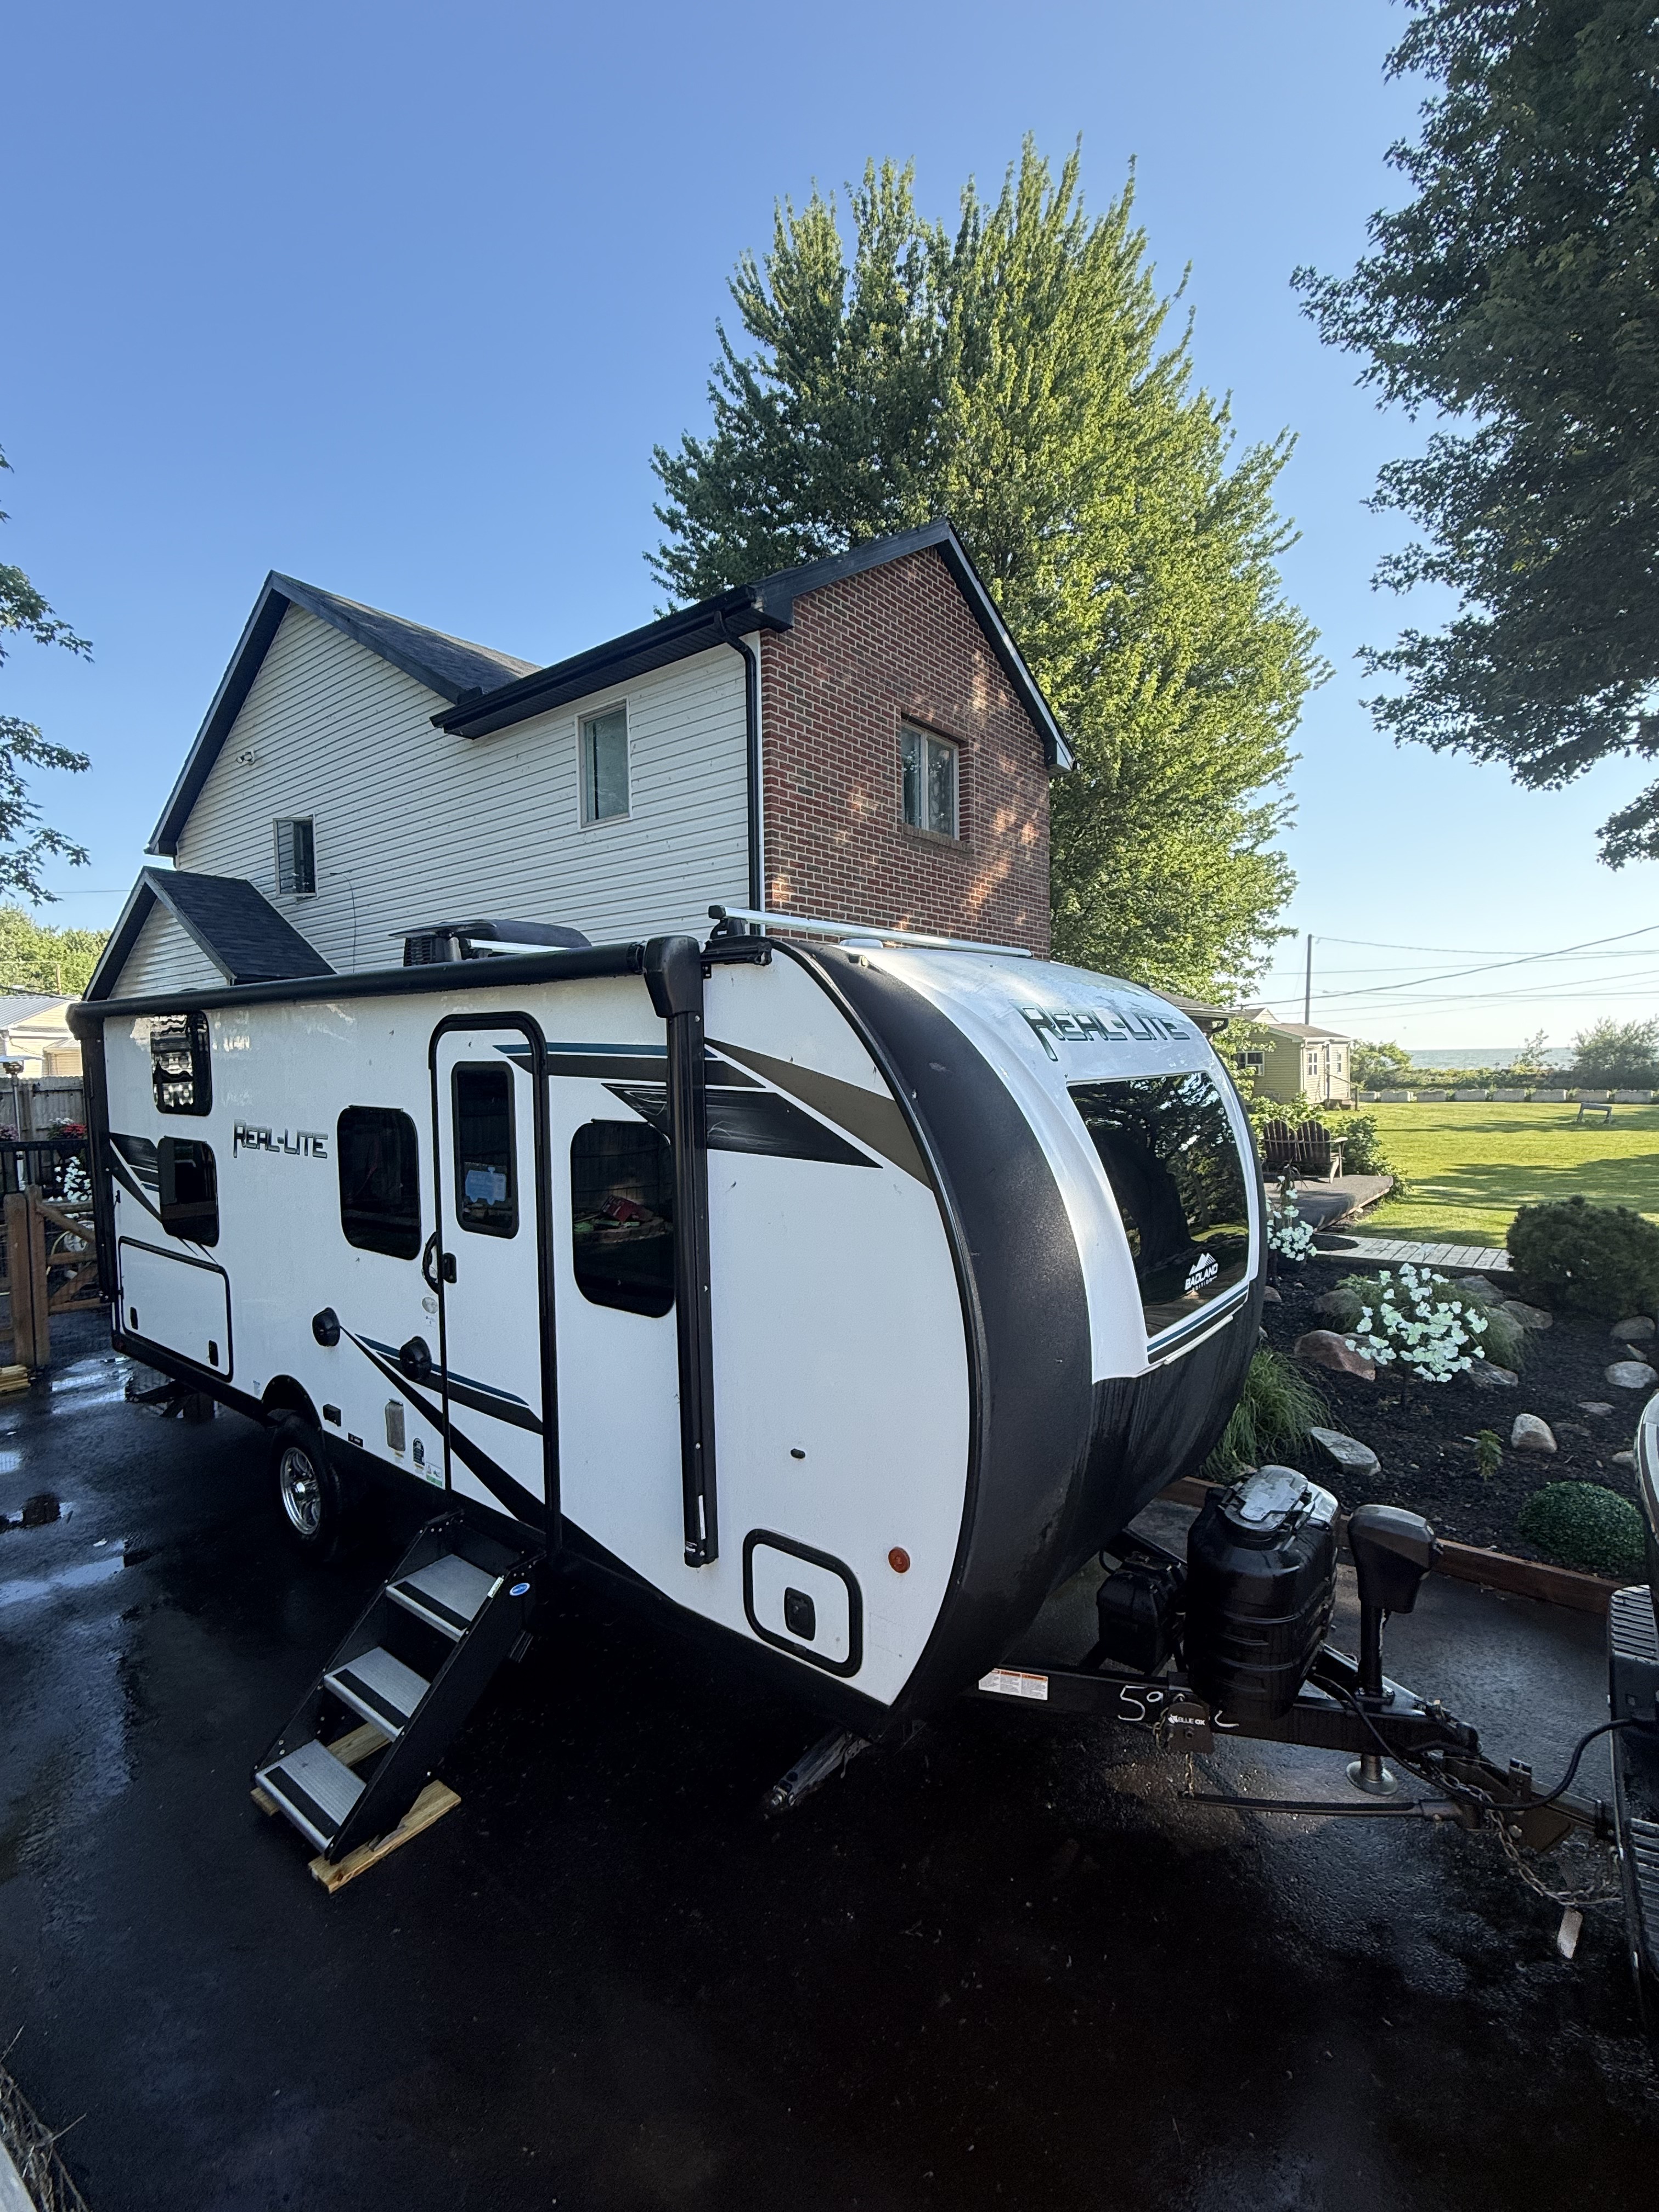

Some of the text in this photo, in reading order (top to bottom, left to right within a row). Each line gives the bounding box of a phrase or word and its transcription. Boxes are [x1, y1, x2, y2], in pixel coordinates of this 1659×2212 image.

[1008, 998, 1191, 1062] REAL-LITE
[233, 1119, 329, 1159] REAL-LITE
[1184, 1263, 1218, 1291] BADLAND
[1178, 1717, 1194, 1725] BLUE
